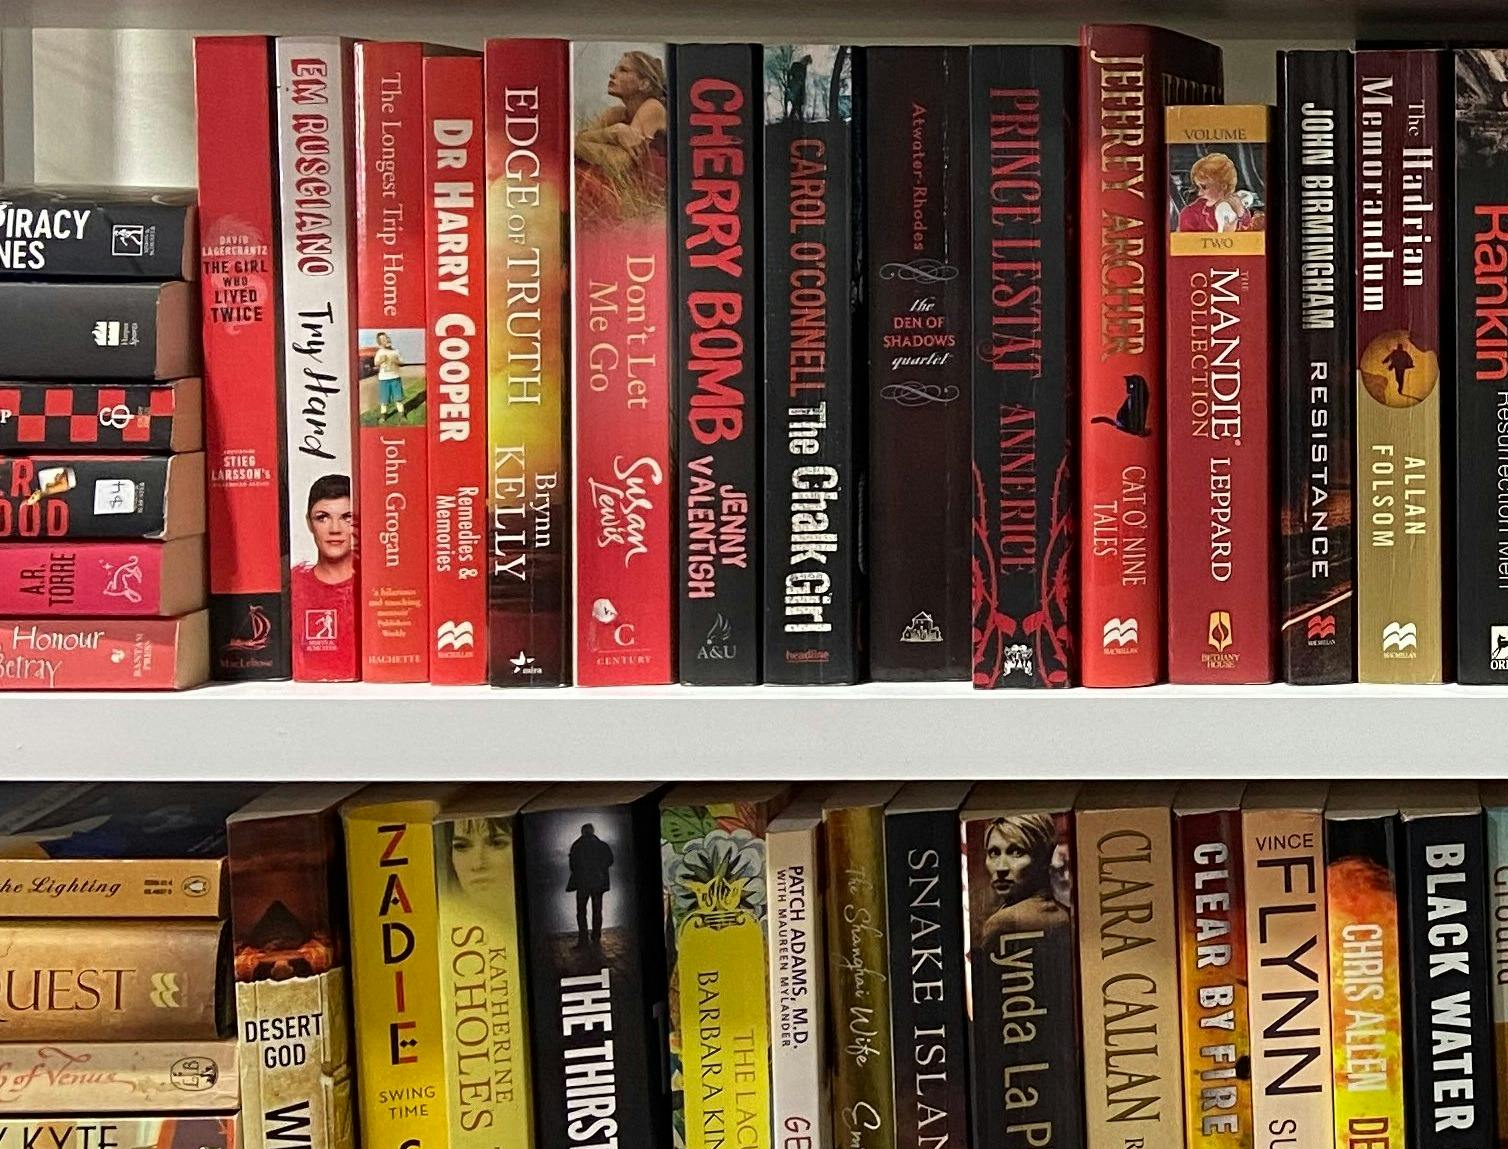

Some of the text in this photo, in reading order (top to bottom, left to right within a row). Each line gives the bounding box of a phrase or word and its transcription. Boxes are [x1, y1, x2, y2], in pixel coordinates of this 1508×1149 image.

[788, 138, 827, 234] CAROL
[1184, 128, 1247, 140] VOLUME
[375, 72, 405, 317] The Longest Trip Home
[505, 85, 543, 407] EDGE TRUTH
[1301, 102, 1334, 330] JOHN BIRMINGHAM
[1402, 146, 1434, 287] Hadrian
[203, 259, 268, 274] THE GIRL
[211, 306, 264, 323] TWICE
[215, 289, 257, 304] LIVED
[433, 181, 476, 443] HARRY COOPER
[685, 77, 745, 445] CHERRY BOMB
[883, 334, 956, 348] SHADOWS
[893, 316, 945, 329] DEN OF
[380, 437, 407, 486] John
[494, 445, 526, 581] KELLY
[530, 472, 558, 549] Brynn
[784, 401, 839, 634] The Chalk Girl
[1310, 361, 1329, 579] RESISTANCE
[1371, 445, 1394, 548] FOLSOM
[1404, 456, 1426, 536] ALLAN
[380, 492, 407, 567] Grogan
[687, 455, 715, 599] VALENTISH
[719, 484, 747, 570] JENNY
[1093, 501, 1119, 557] TALES
[1122, 466, 1146, 586] CAT NINE
[1209, 457, 1232, 583] LEPPARD
[1095, 830, 1157, 960] CLARA
[1256, 833, 1314, 851] VINCE
[907, 849, 944, 1004] SNAKE
[1425, 843, 1470, 979] BLACK
[245, 1013, 323, 1043] DESERT
[450, 925, 494, 1132] SCHOLES
[560, 969, 613, 1036] THE
[988, 930, 1048, 1046] Lynda
[1193, 842, 1240, 1136] CLEAR BY FIRE
[1256, 857, 1323, 1096] FLYNN
[264, 1043, 307, 1069] GOD
[1004, 1062, 1050, 1113] La
[1429, 991, 1475, 1134] WATER
